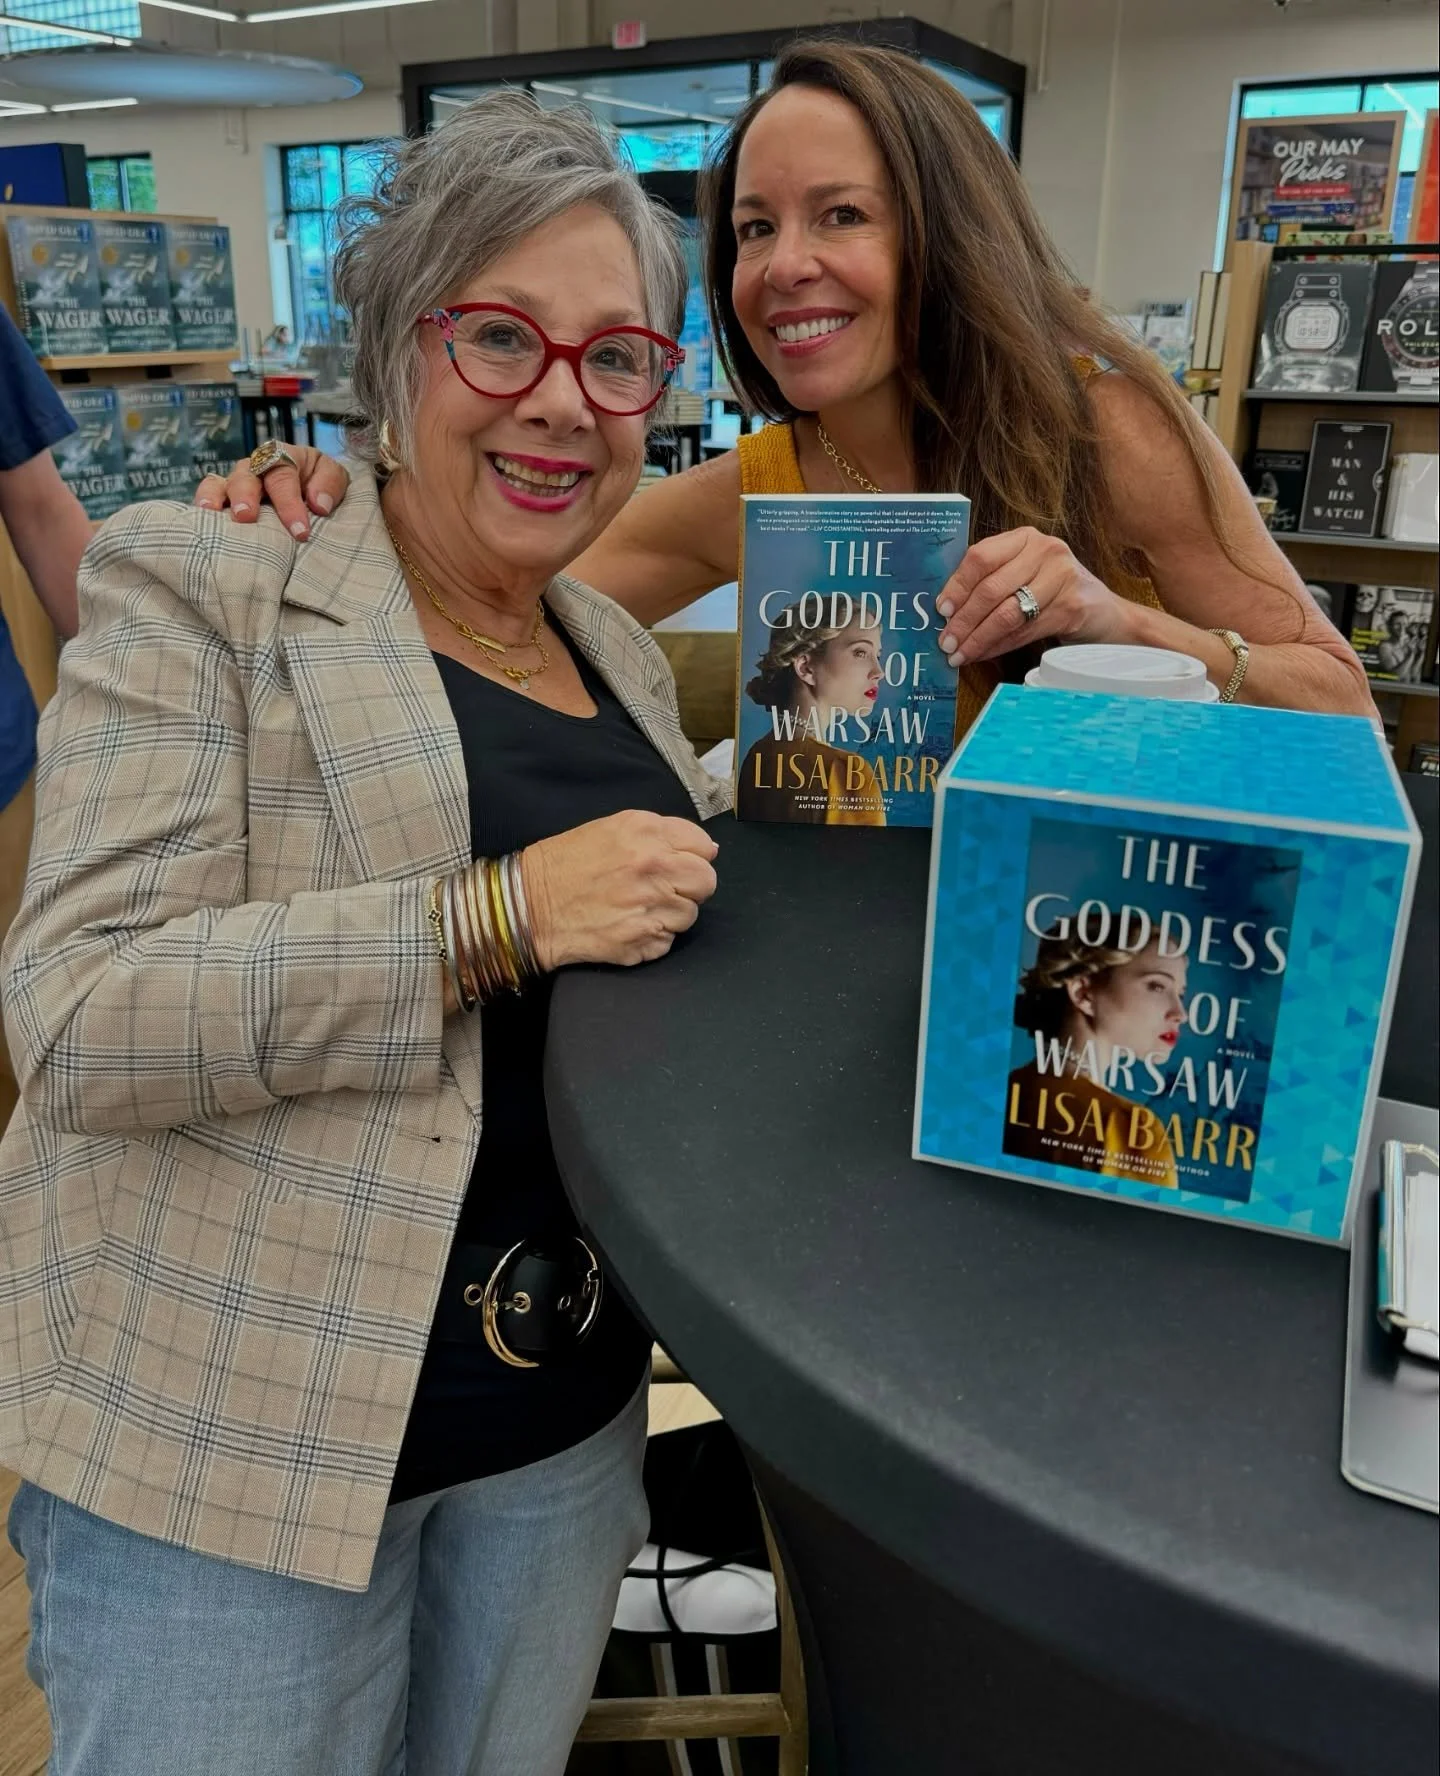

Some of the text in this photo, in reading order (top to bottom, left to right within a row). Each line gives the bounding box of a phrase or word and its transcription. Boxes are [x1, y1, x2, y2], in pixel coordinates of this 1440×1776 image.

[1273, 138, 1364, 158] OUR MAY
[1280, 156, 1347, 187] Picks
[36, 310, 103, 328] WAGER
[105, 308, 170, 326] WAGER
[178, 308, 235, 325] WAGER
[1344, 440, 1353, 450] A
[1331, 457, 1361, 469] MAN
[129, 466, 192, 488] WAGER
[1337, 473, 1348, 486] &
[1328, 489, 1355, 501] HIS
[1313, 506, 1364, 520] WATCH
[824, 540, 893, 576] THE
[759, 590, 946, 630] GODDES
[884, 652, 930, 687] OF
[771, 705, 930, 744] WARSAW
[755, 752, 940, 793] LISA BARR
[1117, 836, 1210, 890] THE
[1025, 893, 1288, 975] GODDESS
[1188, 992, 1252, 1040] OF
[1226, 1048, 1255, 1060] NOVEL
[1034, 1030, 1247, 1110] WARSAW
[1009, 1082, 1256, 1170] LISA BARR
[1041, 1137, 1210, 1177] NEW YORK TIMES BESTSELLING AUTHOR
[1082, 1155, 1166, 1178] OF WOMAN ON FIRE
